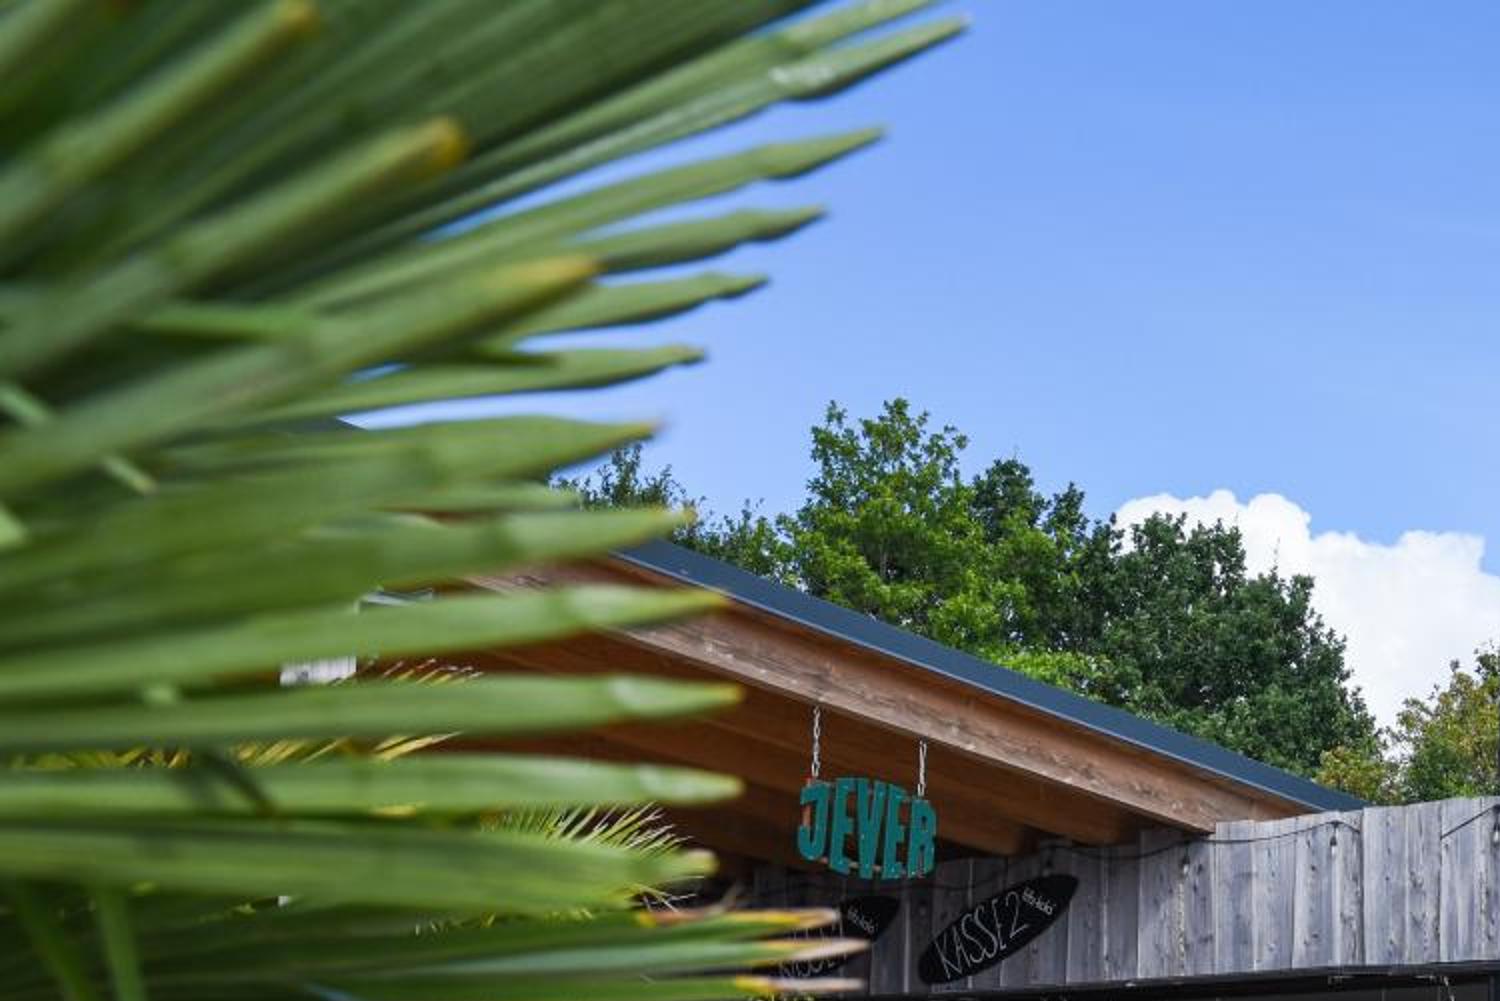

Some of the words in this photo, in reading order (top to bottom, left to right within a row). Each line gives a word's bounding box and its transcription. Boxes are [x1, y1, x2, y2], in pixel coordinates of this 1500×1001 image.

[797, 777, 937, 880] JEVER
[934, 897, 1007, 980] KASSE
[1005, 890, 1031, 939] 2
